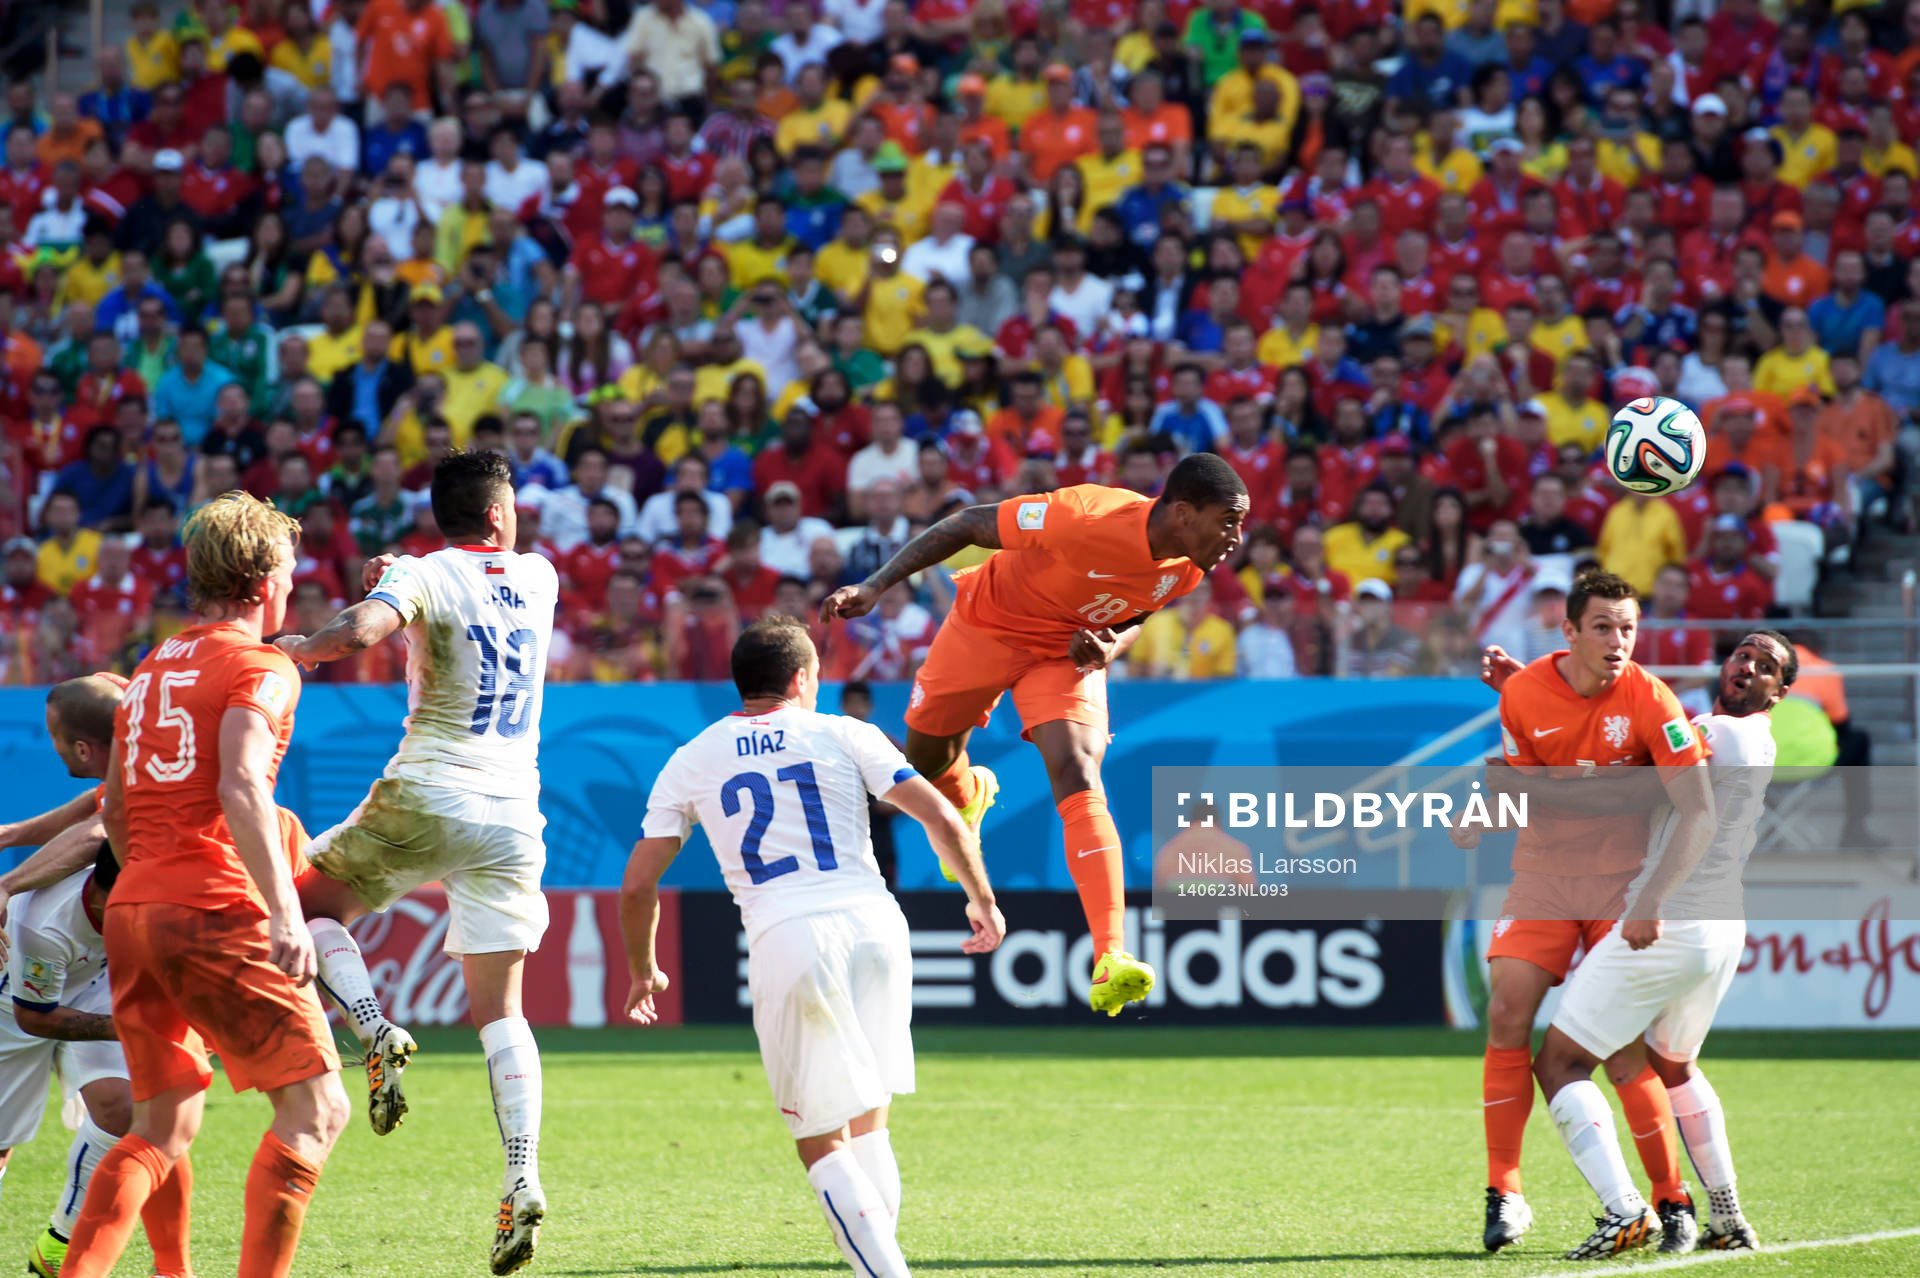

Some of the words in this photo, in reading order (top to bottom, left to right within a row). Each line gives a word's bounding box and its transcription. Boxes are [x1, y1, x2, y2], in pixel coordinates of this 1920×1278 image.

[1077, 593, 1129, 624] 18
[121, 670, 201, 787] 15
[467, 624, 538, 739] 18
[736, 730, 786, 757] DÍAZ
[720, 761, 839, 885] 21
[990, 906, 1384, 1008] adidas
